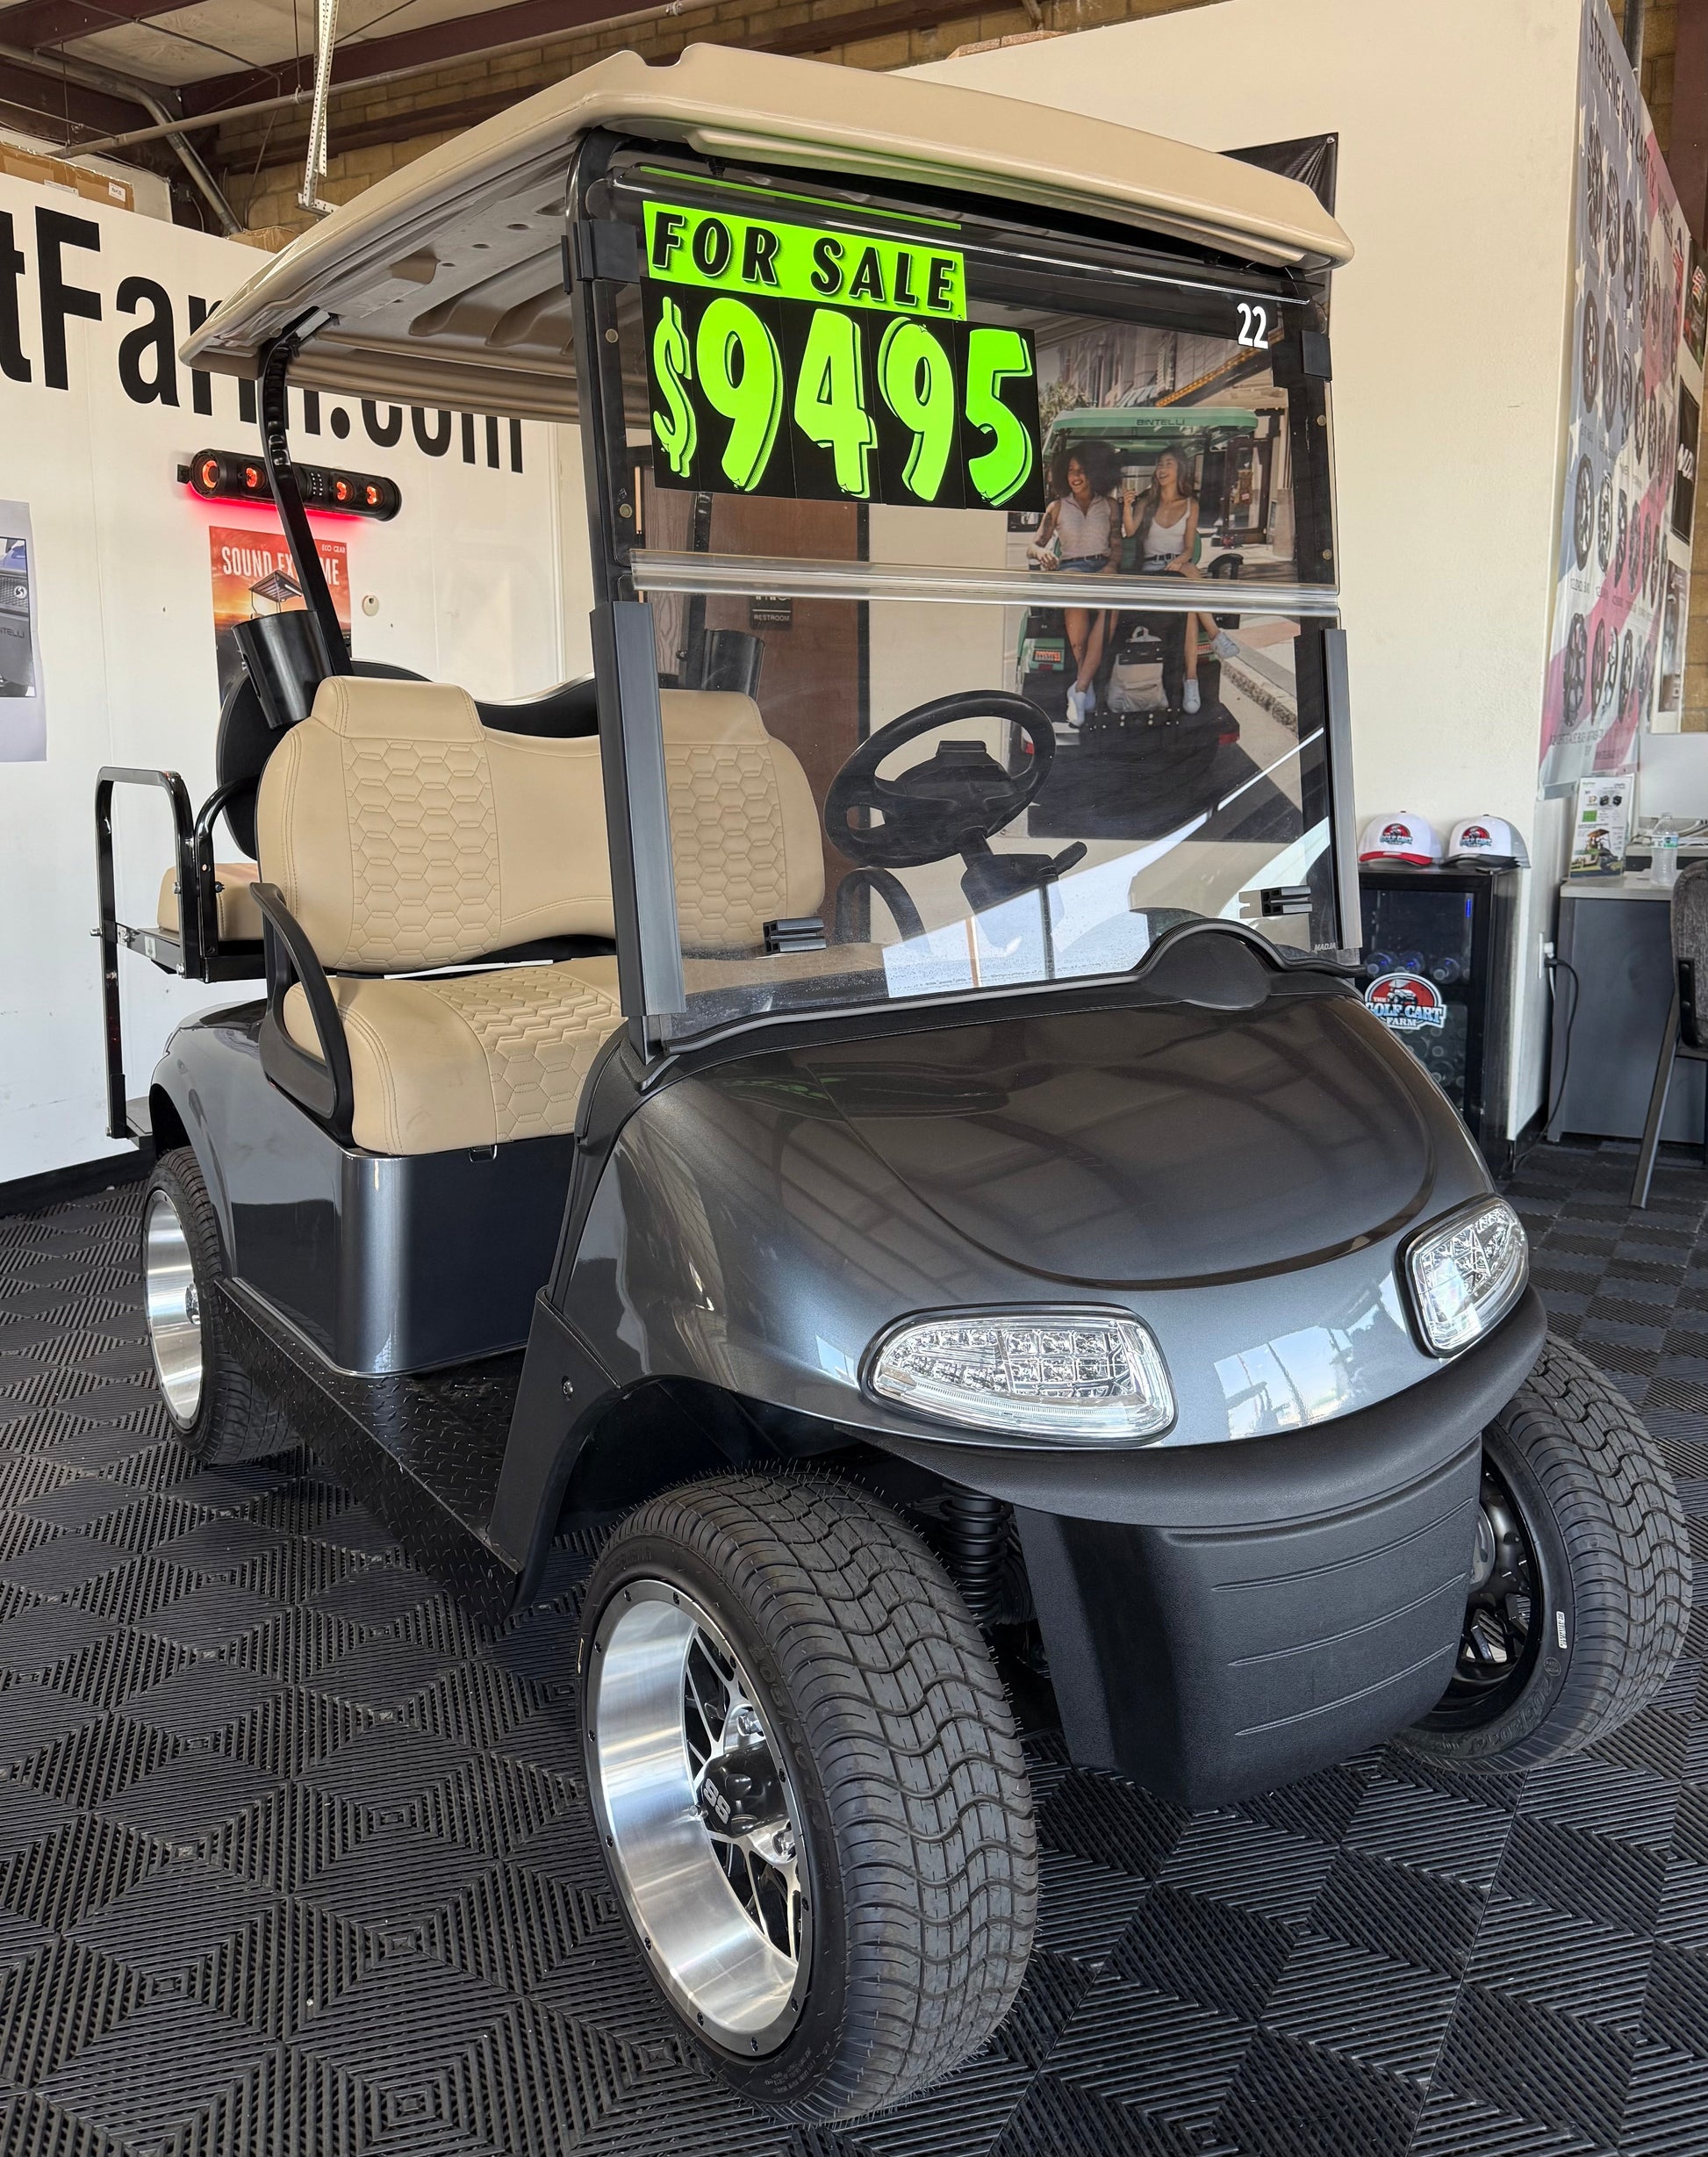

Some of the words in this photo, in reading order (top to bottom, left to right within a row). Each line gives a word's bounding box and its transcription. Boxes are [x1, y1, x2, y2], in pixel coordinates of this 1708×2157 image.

[652, 211, 780, 285] FOR
[810, 238, 958, 312] SALE
[1237, 303, 1269, 349] 22
[653, 296, 1033, 507] $9495
[221, 546, 271, 579] SOUND
[321, 540, 332, 552] ECO
[333, 541, 346, 554] GEAR
[1366, 1003, 1403, 1017] GOLF
[1404, 1004, 1442, 1024] CART
[1387, 1017, 1417, 1026] FARM
[703, 1778, 731, 1825] SS
